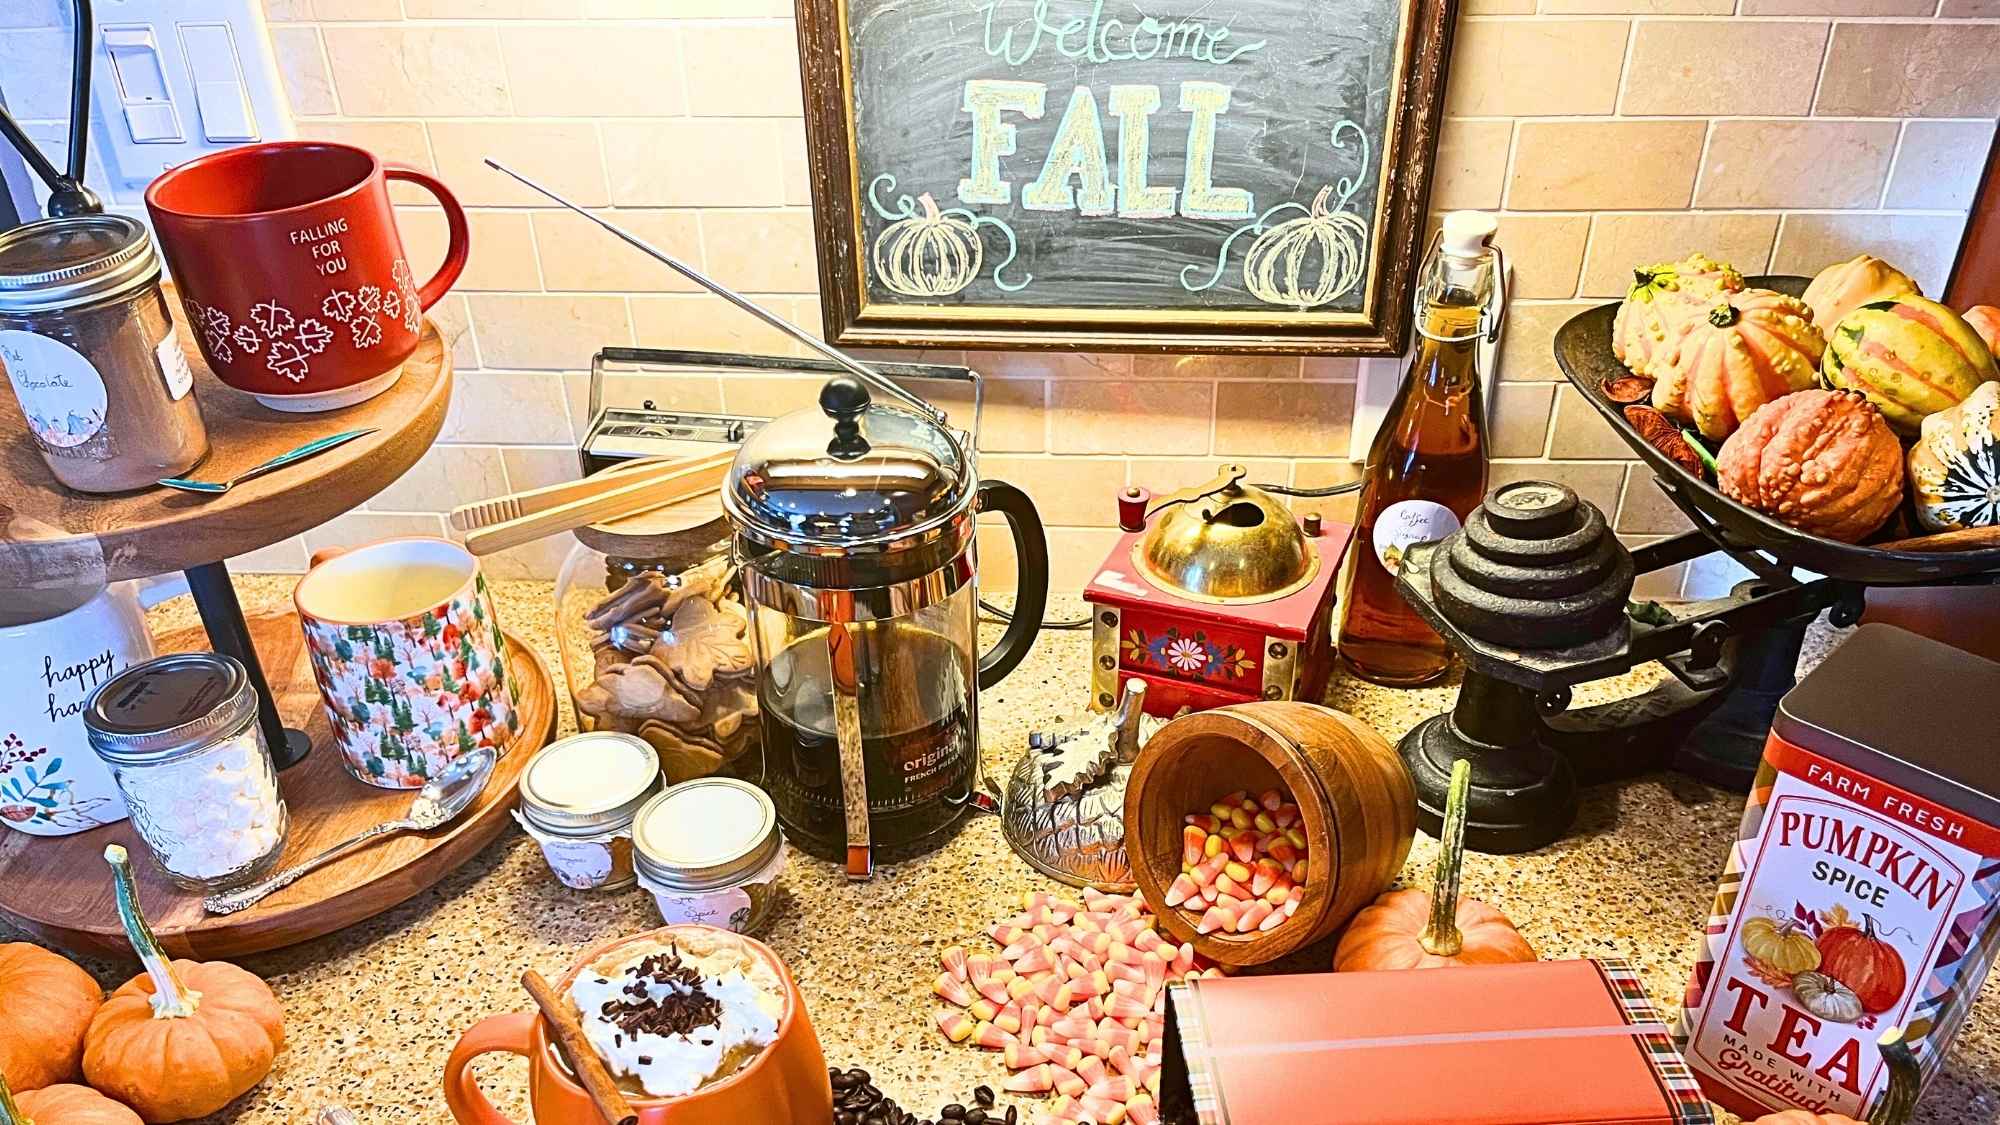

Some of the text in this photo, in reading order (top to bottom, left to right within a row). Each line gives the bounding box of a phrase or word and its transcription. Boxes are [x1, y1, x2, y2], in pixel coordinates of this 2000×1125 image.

[975, 0, 1267, 65] Welcome
[957, 79, 1256, 219] FALL
[290, 217, 348, 245] FALLING
[311, 240, 342, 259] FOR
[315, 256, 347, 276] YOU
[41, 649, 115, 692] happy
[904, 765, 938, 785] FRENCH
[1807, 764, 1965, 840] FARM FRESH
[1779, 811, 1955, 911] PUMPKIN
[1811, 860, 1890, 909] SPICE
[1723, 976, 1862, 1096] TEA
[1723, 1034, 1841, 1102] MADE WITH
